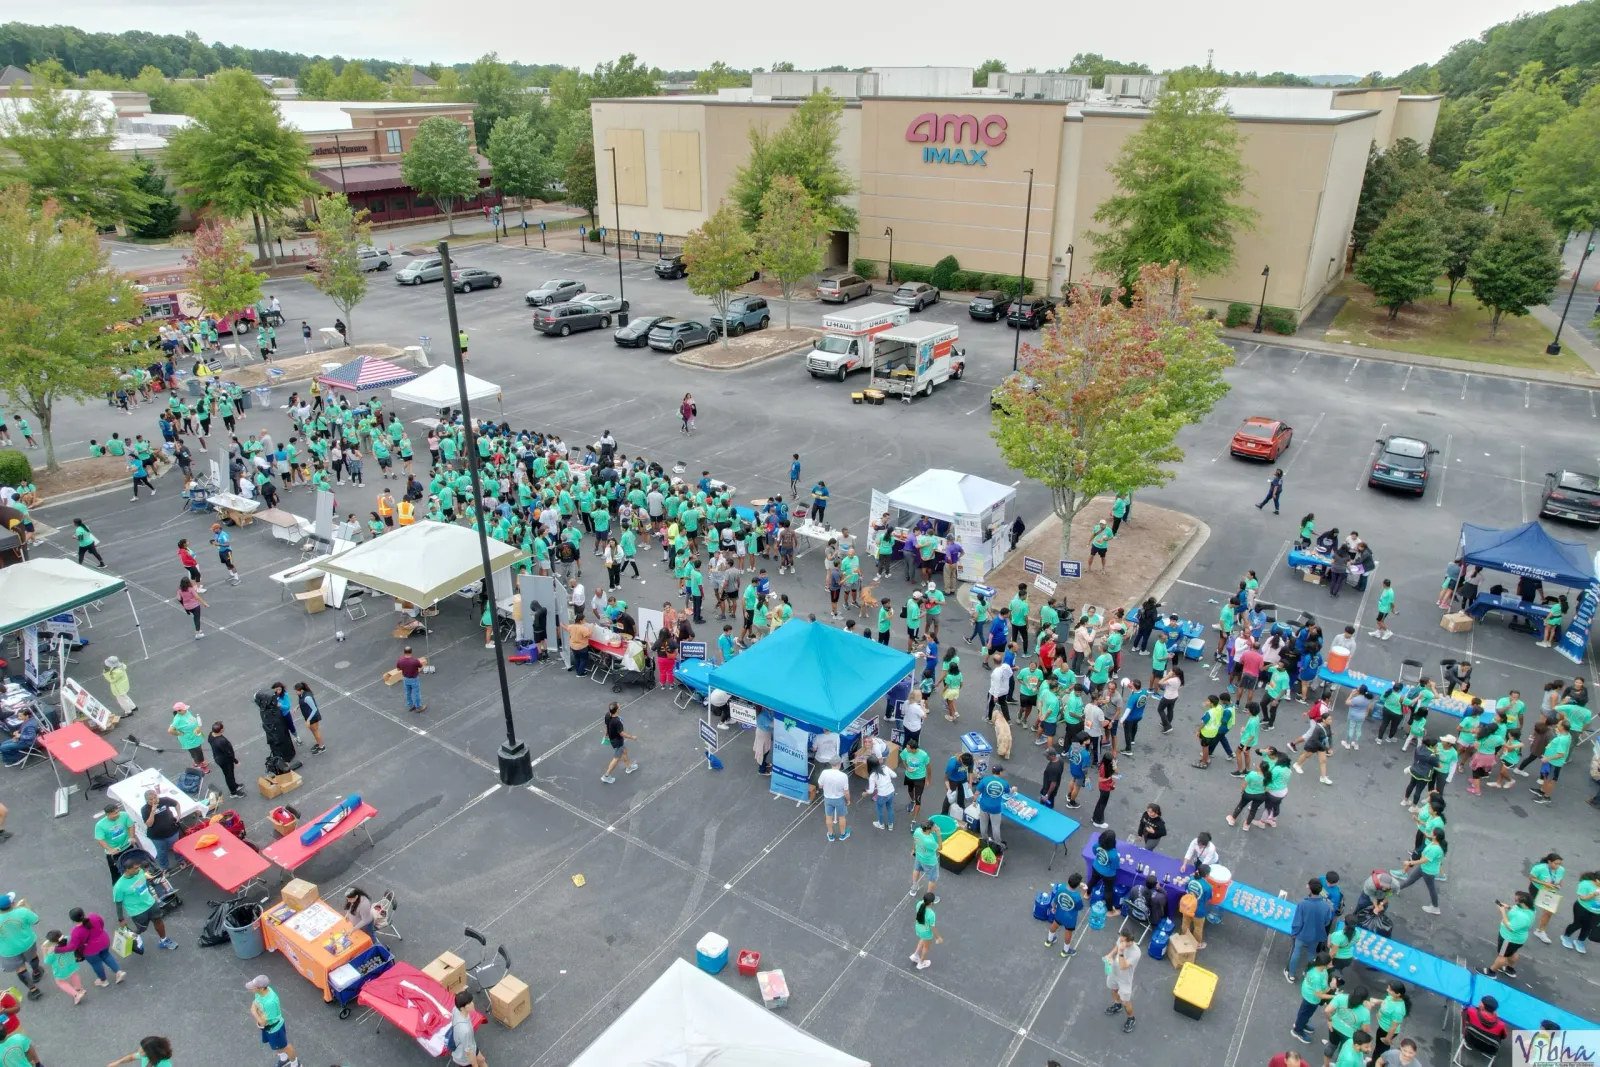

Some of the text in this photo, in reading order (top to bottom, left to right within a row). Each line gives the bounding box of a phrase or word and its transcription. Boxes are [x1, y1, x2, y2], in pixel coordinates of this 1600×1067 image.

[922, 147, 988, 166] IMAX
[1503, 562, 1558, 579] NORTHSIDE
[1511, 569, 1545, 580] HOSPITAL
[732, 708, 756, 720] Fleming
[774, 743, 804, 761] DEMOCRATS
